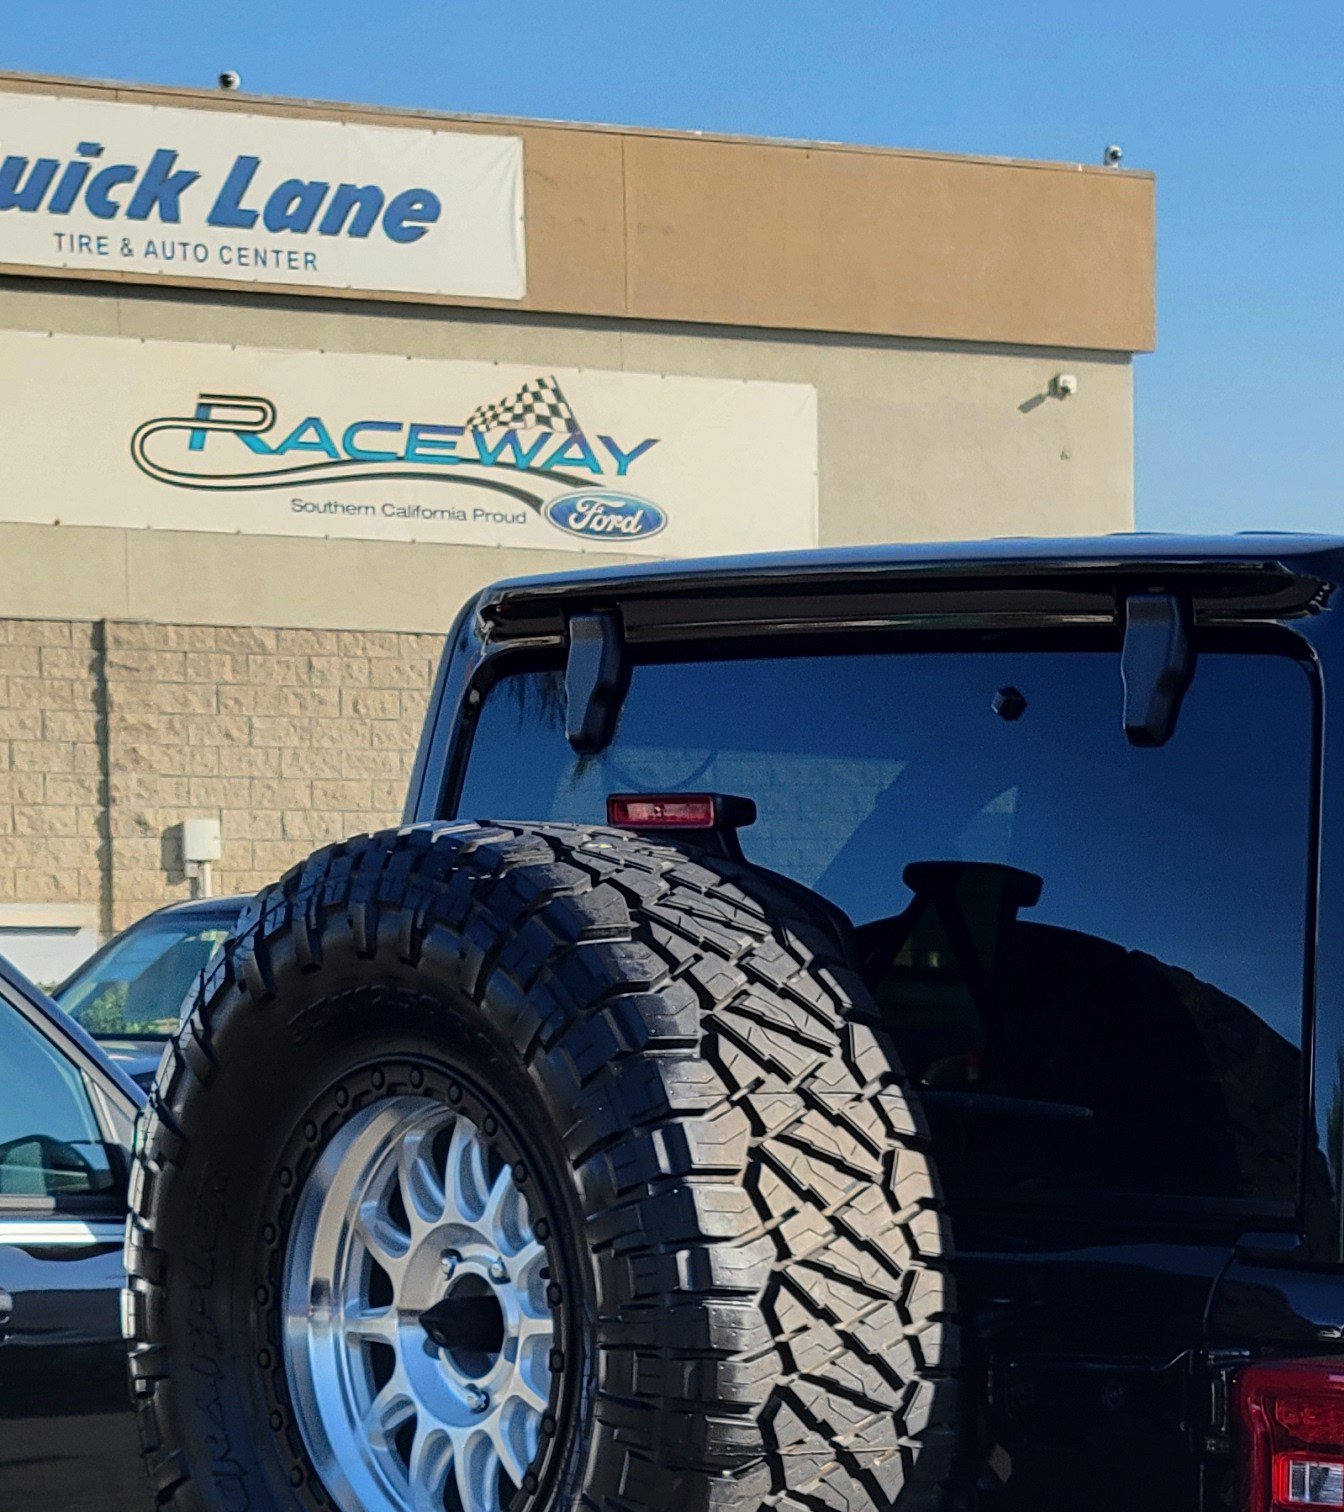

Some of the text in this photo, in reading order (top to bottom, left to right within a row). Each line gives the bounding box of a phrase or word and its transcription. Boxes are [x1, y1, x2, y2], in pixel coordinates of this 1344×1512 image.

[206, 155, 442, 244] Lane
[53, 232, 318, 271] TIRE & AUTO CENTER
[186, 393, 662, 476] RACEWAY
[290, 498, 526, 525] Southern California Proud
[568, 497, 643, 535] Ford
